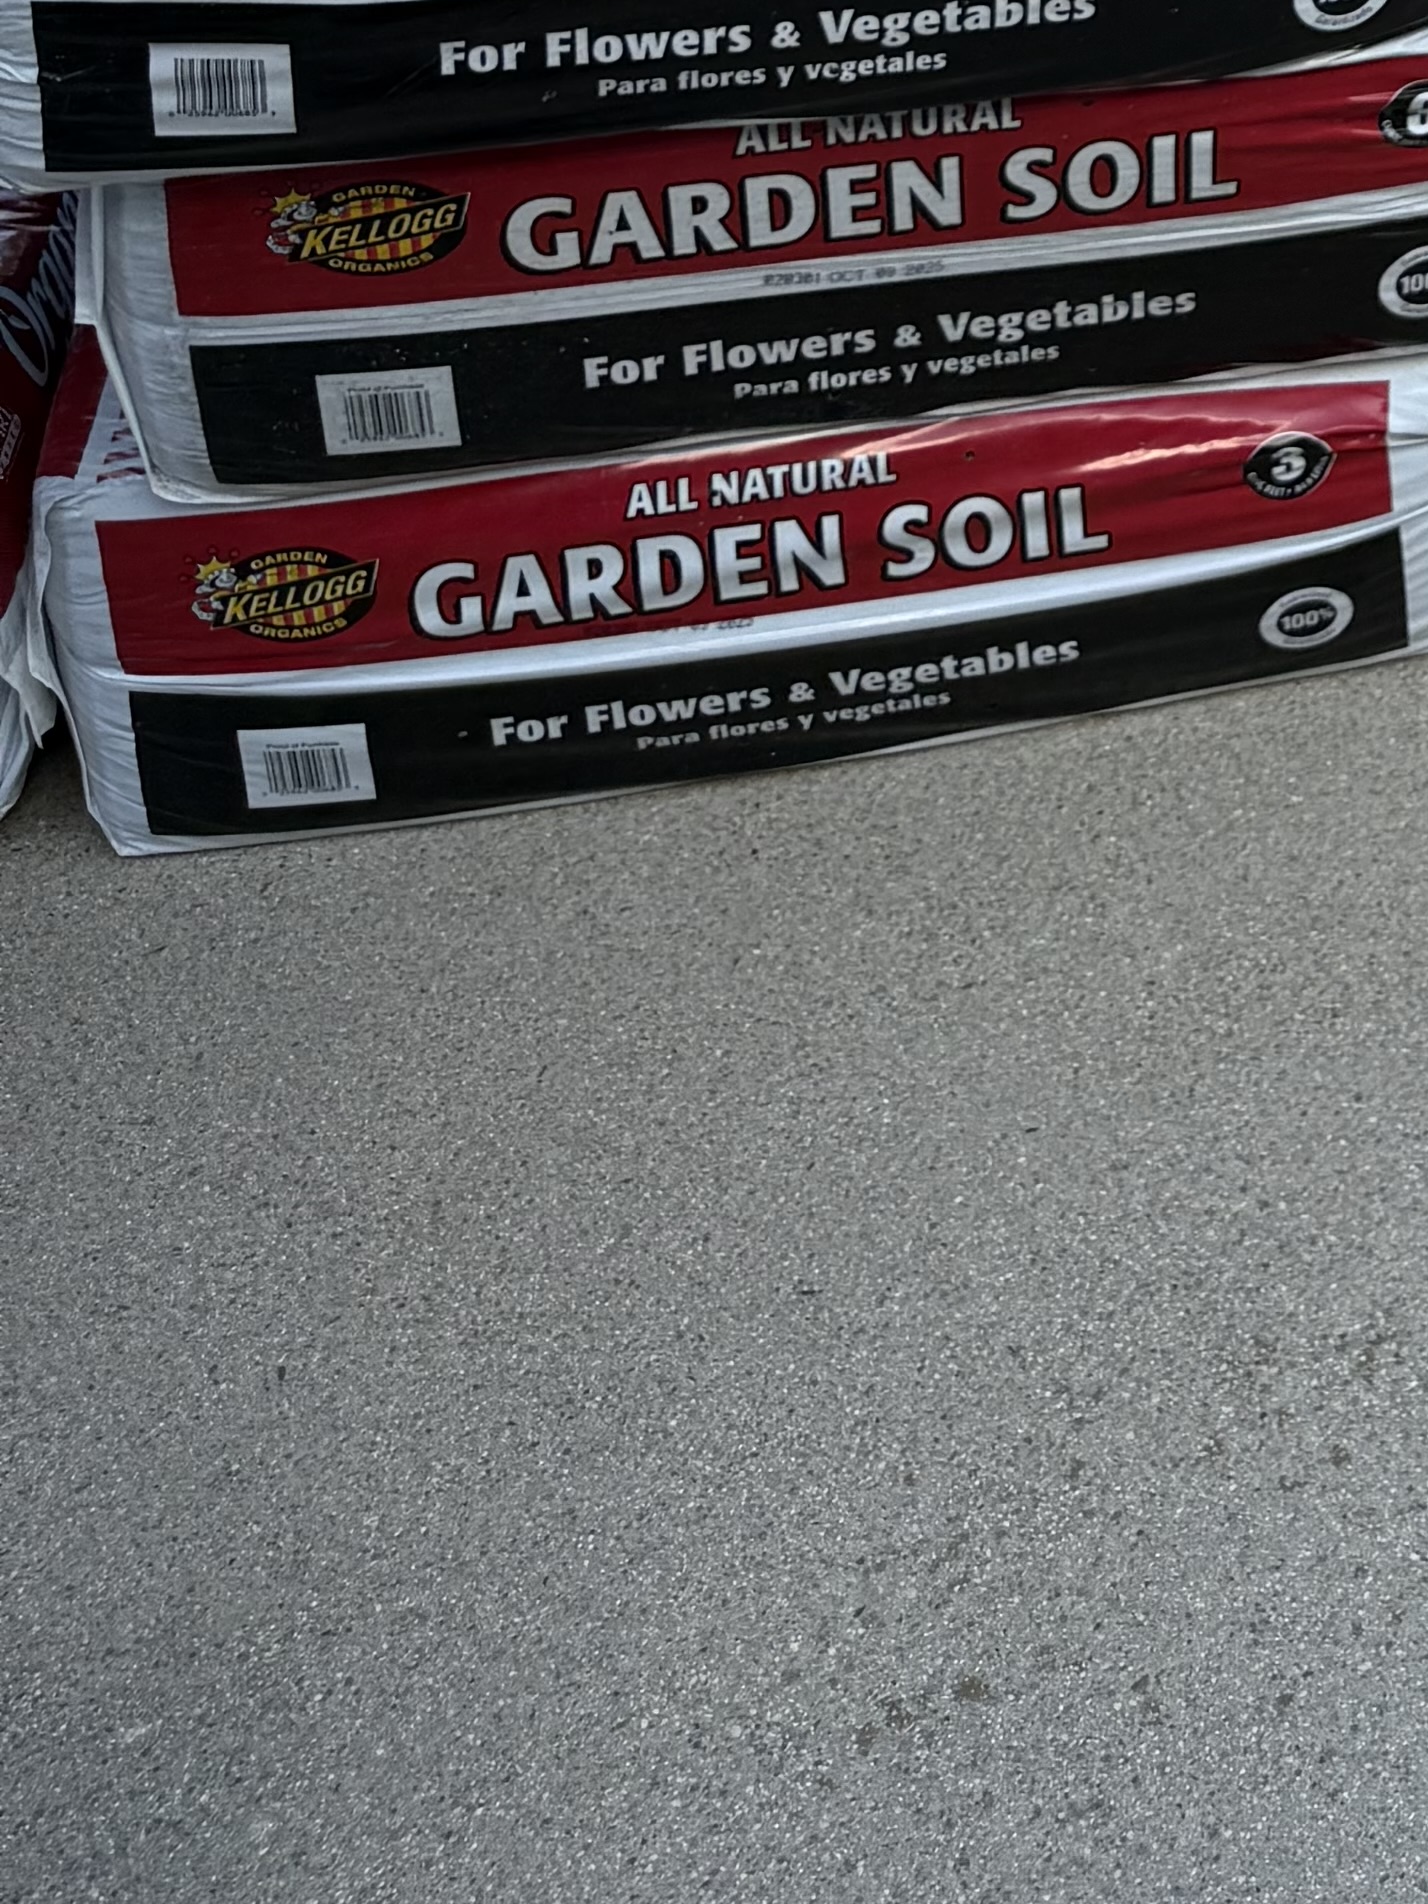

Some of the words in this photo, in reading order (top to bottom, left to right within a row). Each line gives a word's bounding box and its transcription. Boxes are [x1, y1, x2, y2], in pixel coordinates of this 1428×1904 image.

[440, 41, 525, 75] For
[546, 25, 751, 67] Flowers
[771, 22, 800, 48] &
[297, 198, 458, 259] KELLOGG
[507, 156, 961, 270] GARDEN
[1005, 131, 1237, 218] SOIL
[627, 478, 698, 517] ALL
[712, 453, 894, 504] NATURAL
[415, 515, 845, 636] GARDEN
[883, 487, 1108, 576] SOIL
